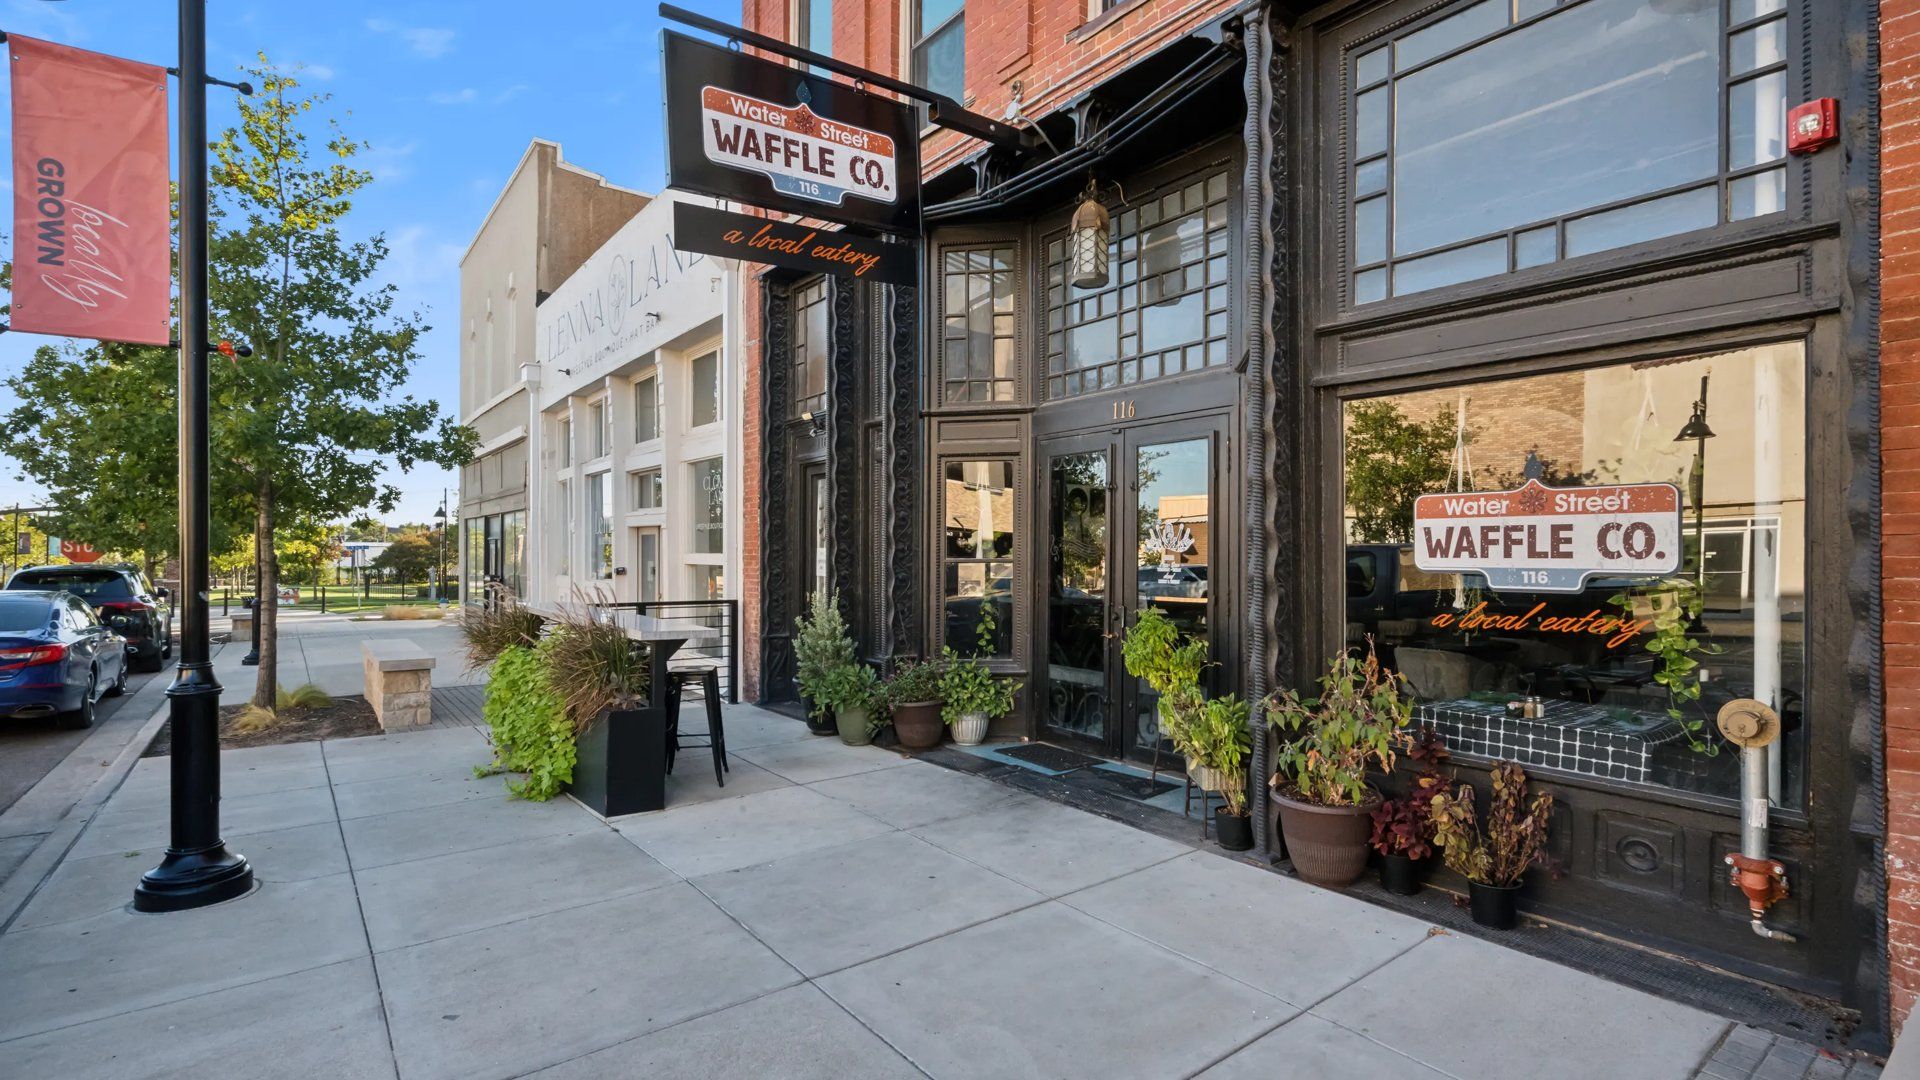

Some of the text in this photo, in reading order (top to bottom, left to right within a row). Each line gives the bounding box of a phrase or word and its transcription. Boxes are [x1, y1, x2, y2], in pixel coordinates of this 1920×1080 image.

[730, 97, 869, 150] Water Street
[711, 118, 890, 192] WAFFLE CO.
[799, 180, 819, 196] 116
[37, 157, 65, 266] GROWN
[723, 224, 881, 276] a local eatery
[545, 233, 705, 363] LENNA LAN
[1113, 400, 1135, 420] 116
[1443, 491, 1631, 516] Water Street
[64, 541, 94, 553] STO
[1423, 520, 1666, 560] WAFFLE CO.
[1521, 570, 1549, 584] 116
[1431, 601, 1652, 649] a local eatery
